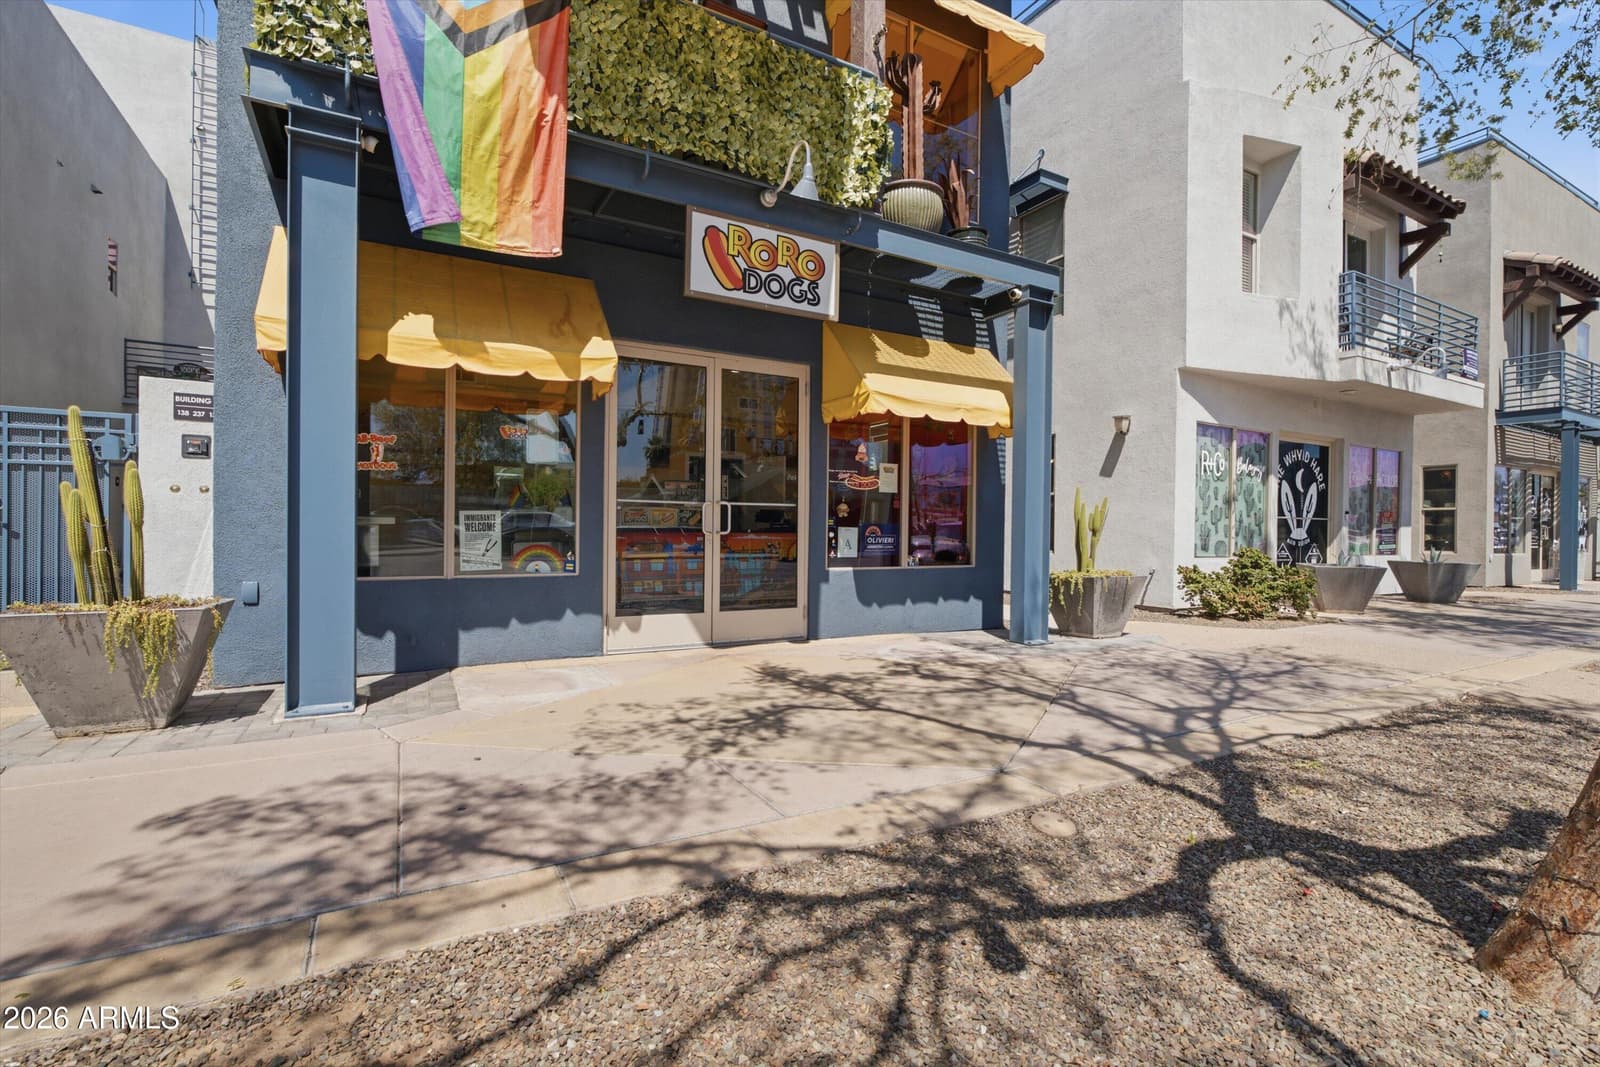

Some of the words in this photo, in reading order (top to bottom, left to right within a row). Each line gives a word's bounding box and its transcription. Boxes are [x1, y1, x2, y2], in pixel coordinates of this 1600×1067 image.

[743, 268, 820, 306] DOGS
[175, 395, 212, 405] BUILDING
[1310, 458, 1326, 491] HARE
[464, 522, 497, 532] WELCOME
